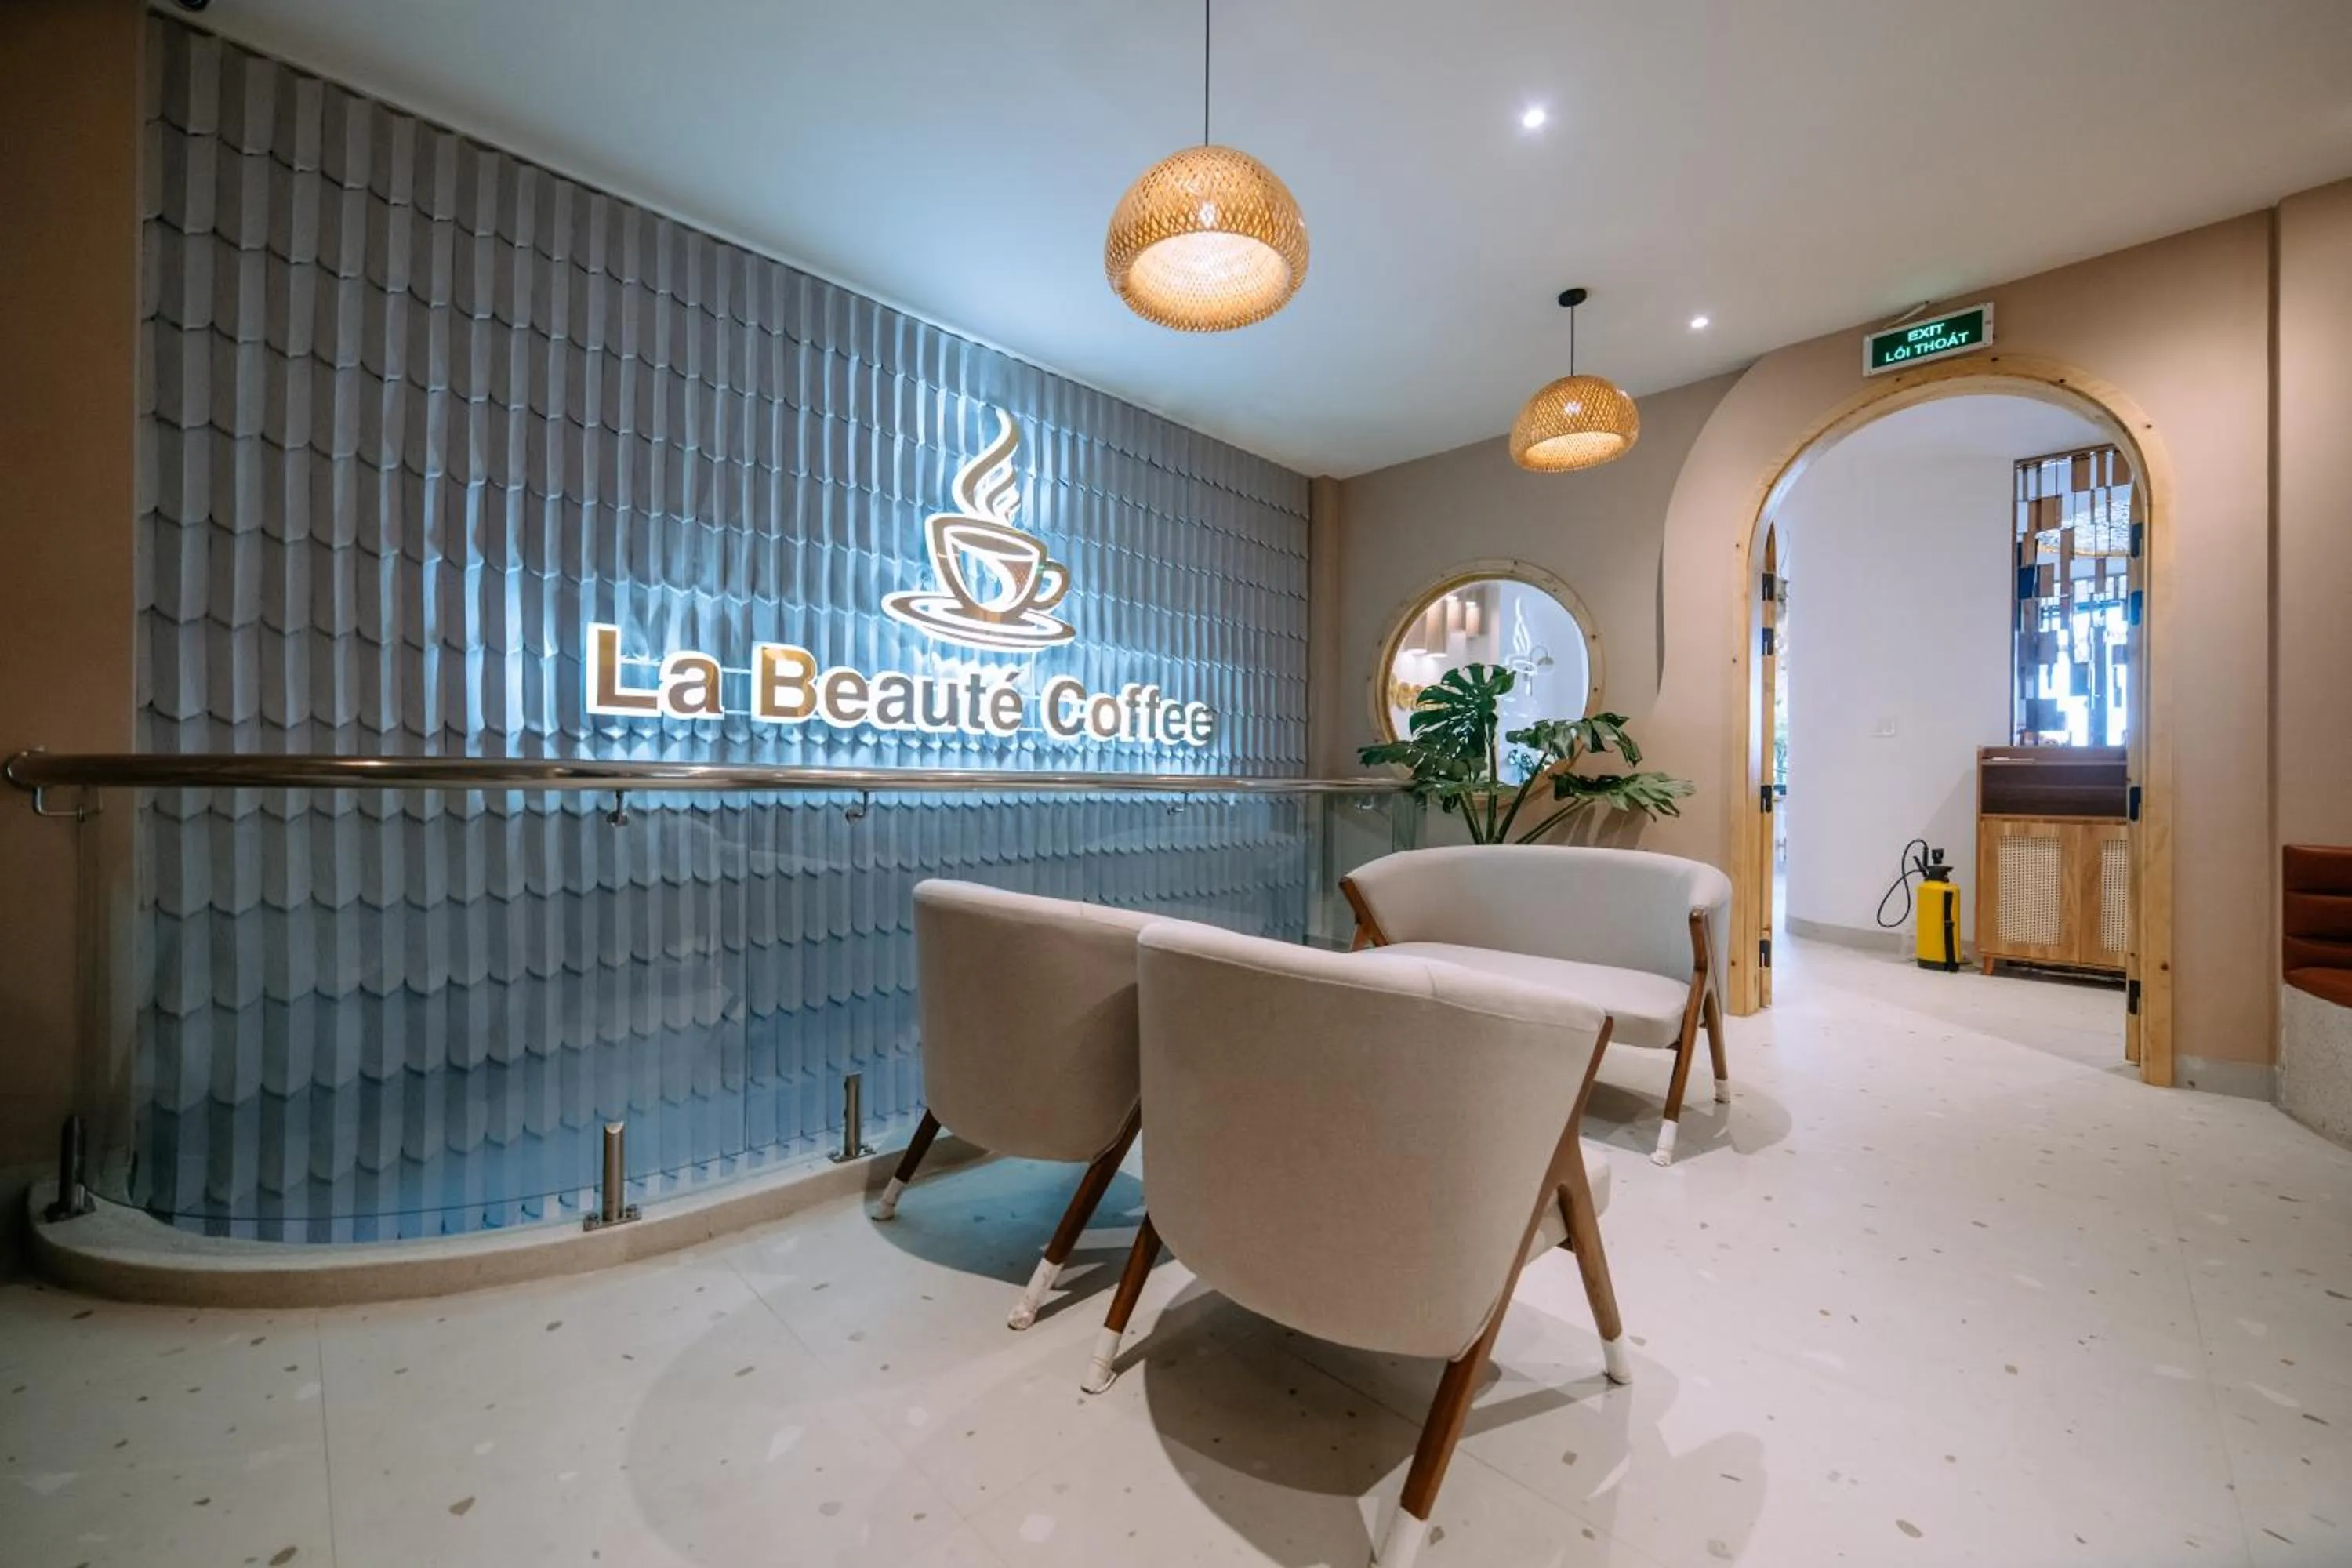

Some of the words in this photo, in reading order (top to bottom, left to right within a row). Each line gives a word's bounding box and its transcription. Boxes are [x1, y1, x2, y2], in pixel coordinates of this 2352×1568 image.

[1907, 323, 1944, 342] EXIT
[1914, 331, 1969, 354] THOÁT
[591, 626, 723, 715] La
[755, 643, 1024, 733] Beauté
[1044, 677, 1214, 742] Coffee
